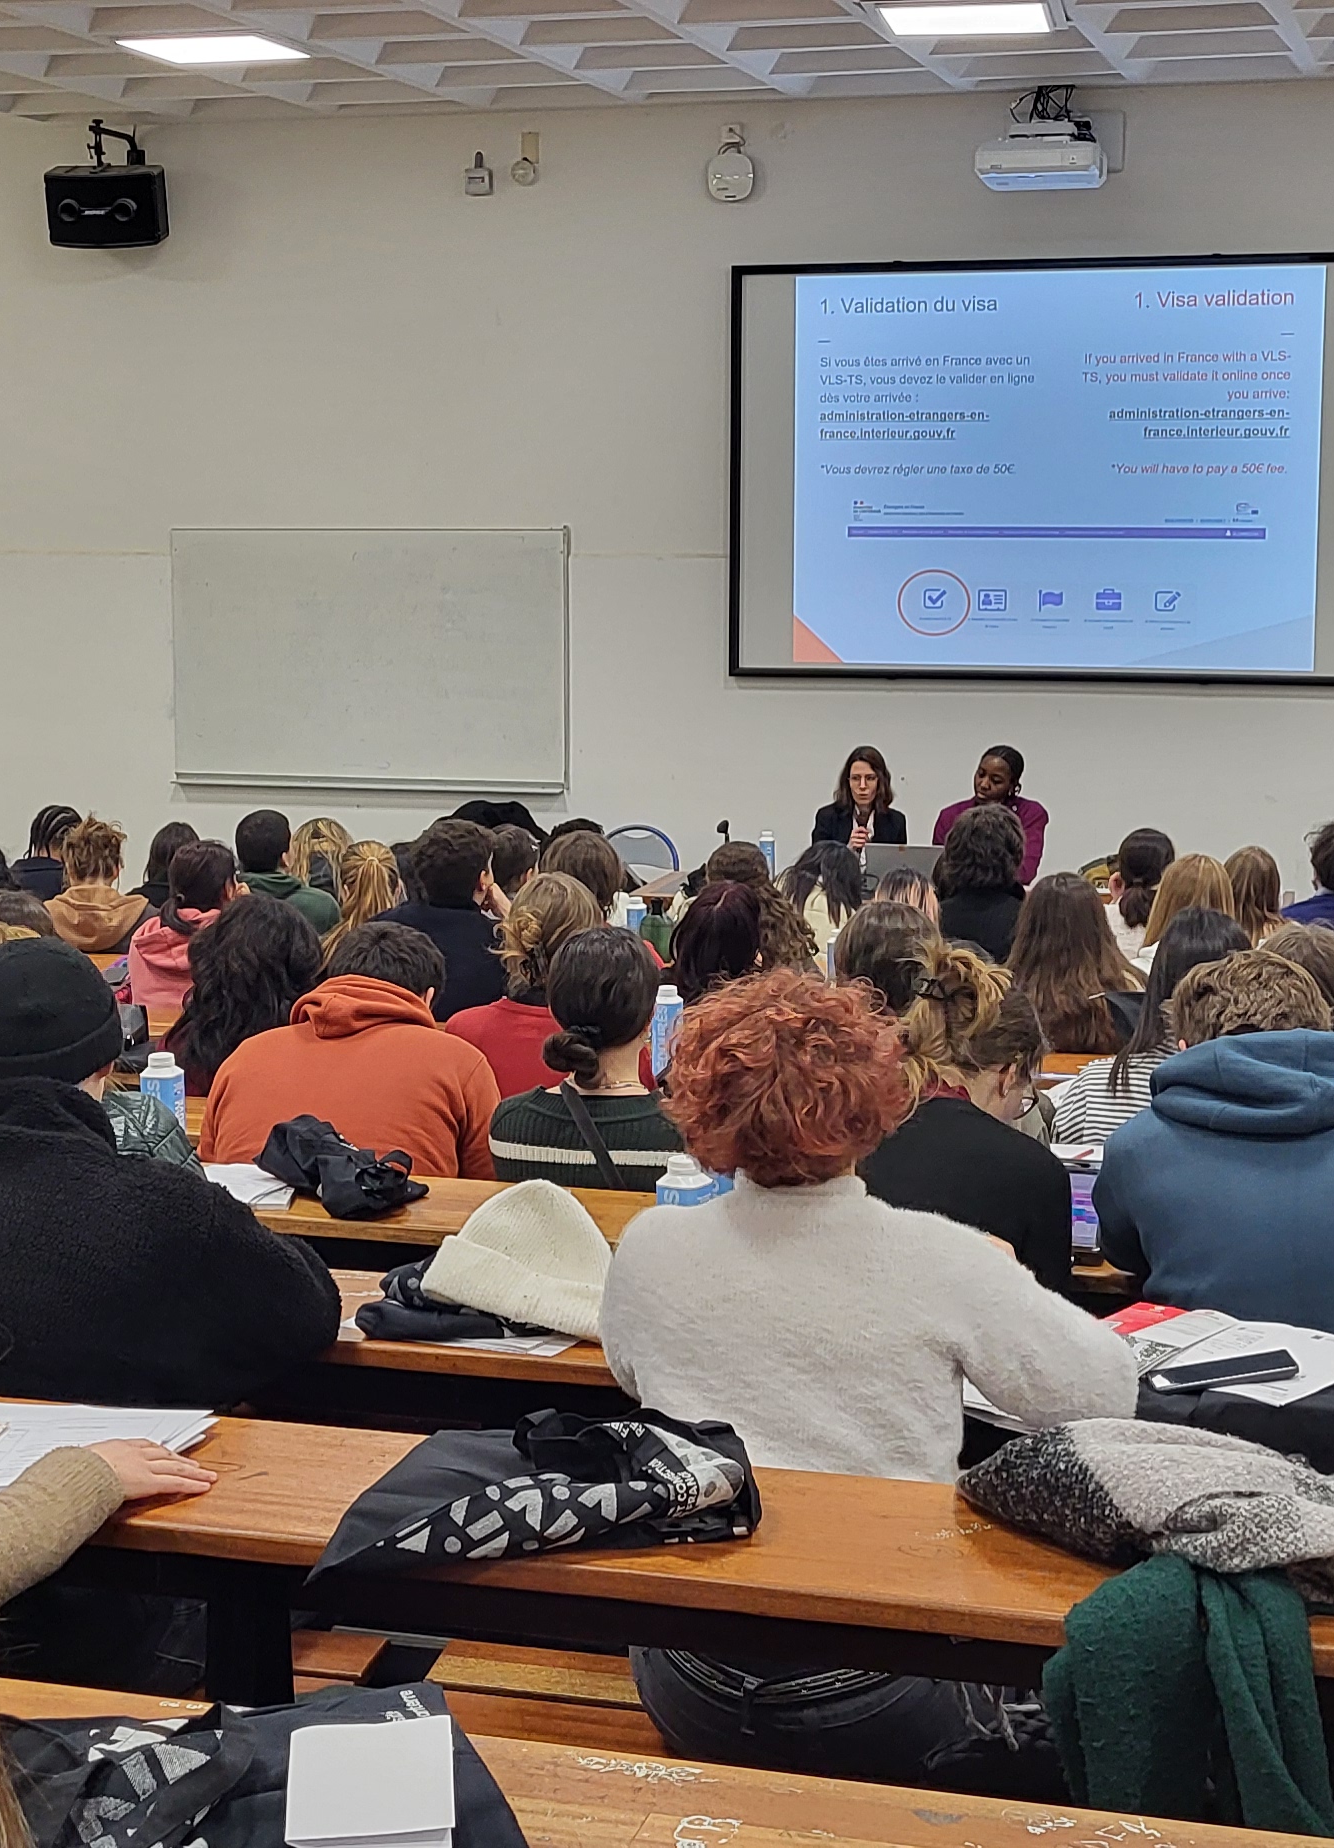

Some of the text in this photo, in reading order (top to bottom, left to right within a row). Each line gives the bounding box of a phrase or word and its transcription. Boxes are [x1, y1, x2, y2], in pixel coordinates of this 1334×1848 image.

[820, 295, 998, 315] 1. Validation du visa
[1135, 289, 1294, 309] 1. Visa validation
[820, 355, 1030, 368] Si vous êtes arrivé en France avec un
[1084, 351, 1291, 367] If you arrived in France with a VLS-
[819, 372, 1035, 387] VLS-TS, vous devez le valider en ligne
[1082, 370, 1290, 385] TS, you must validate it online once
[820, 392, 839, 403] dès
[843, 393, 870, 403] votre
[874, 391, 912, 403] arrivée
[1227, 388, 1290, 402] you arrive:
[820, 410, 990, 423] administration-etrangers-en-
[1109, 408, 1290, 421] administration-etrangers-en-
[820, 427, 956, 440] france.interieur.gouv.fr
[1143, 426, 1290, 439] france.interieur.gouv.fr
[854, 464, 890, 475] devrez
[893, 463, 923, 477] régler
[927, 465, 946, 475] une
[950, 464, 973, 474] taxe
[976, 463, 990, 474] de
[1141, 463, 1158, 474] will
[1161, 463, 1189, 474] have
[1192, 463, 1203, 474] to
[1206, 465, 1228, 476] pay
[1231, 465, 1238, 474] a
[1242, 463, 1263, 474] 50€
